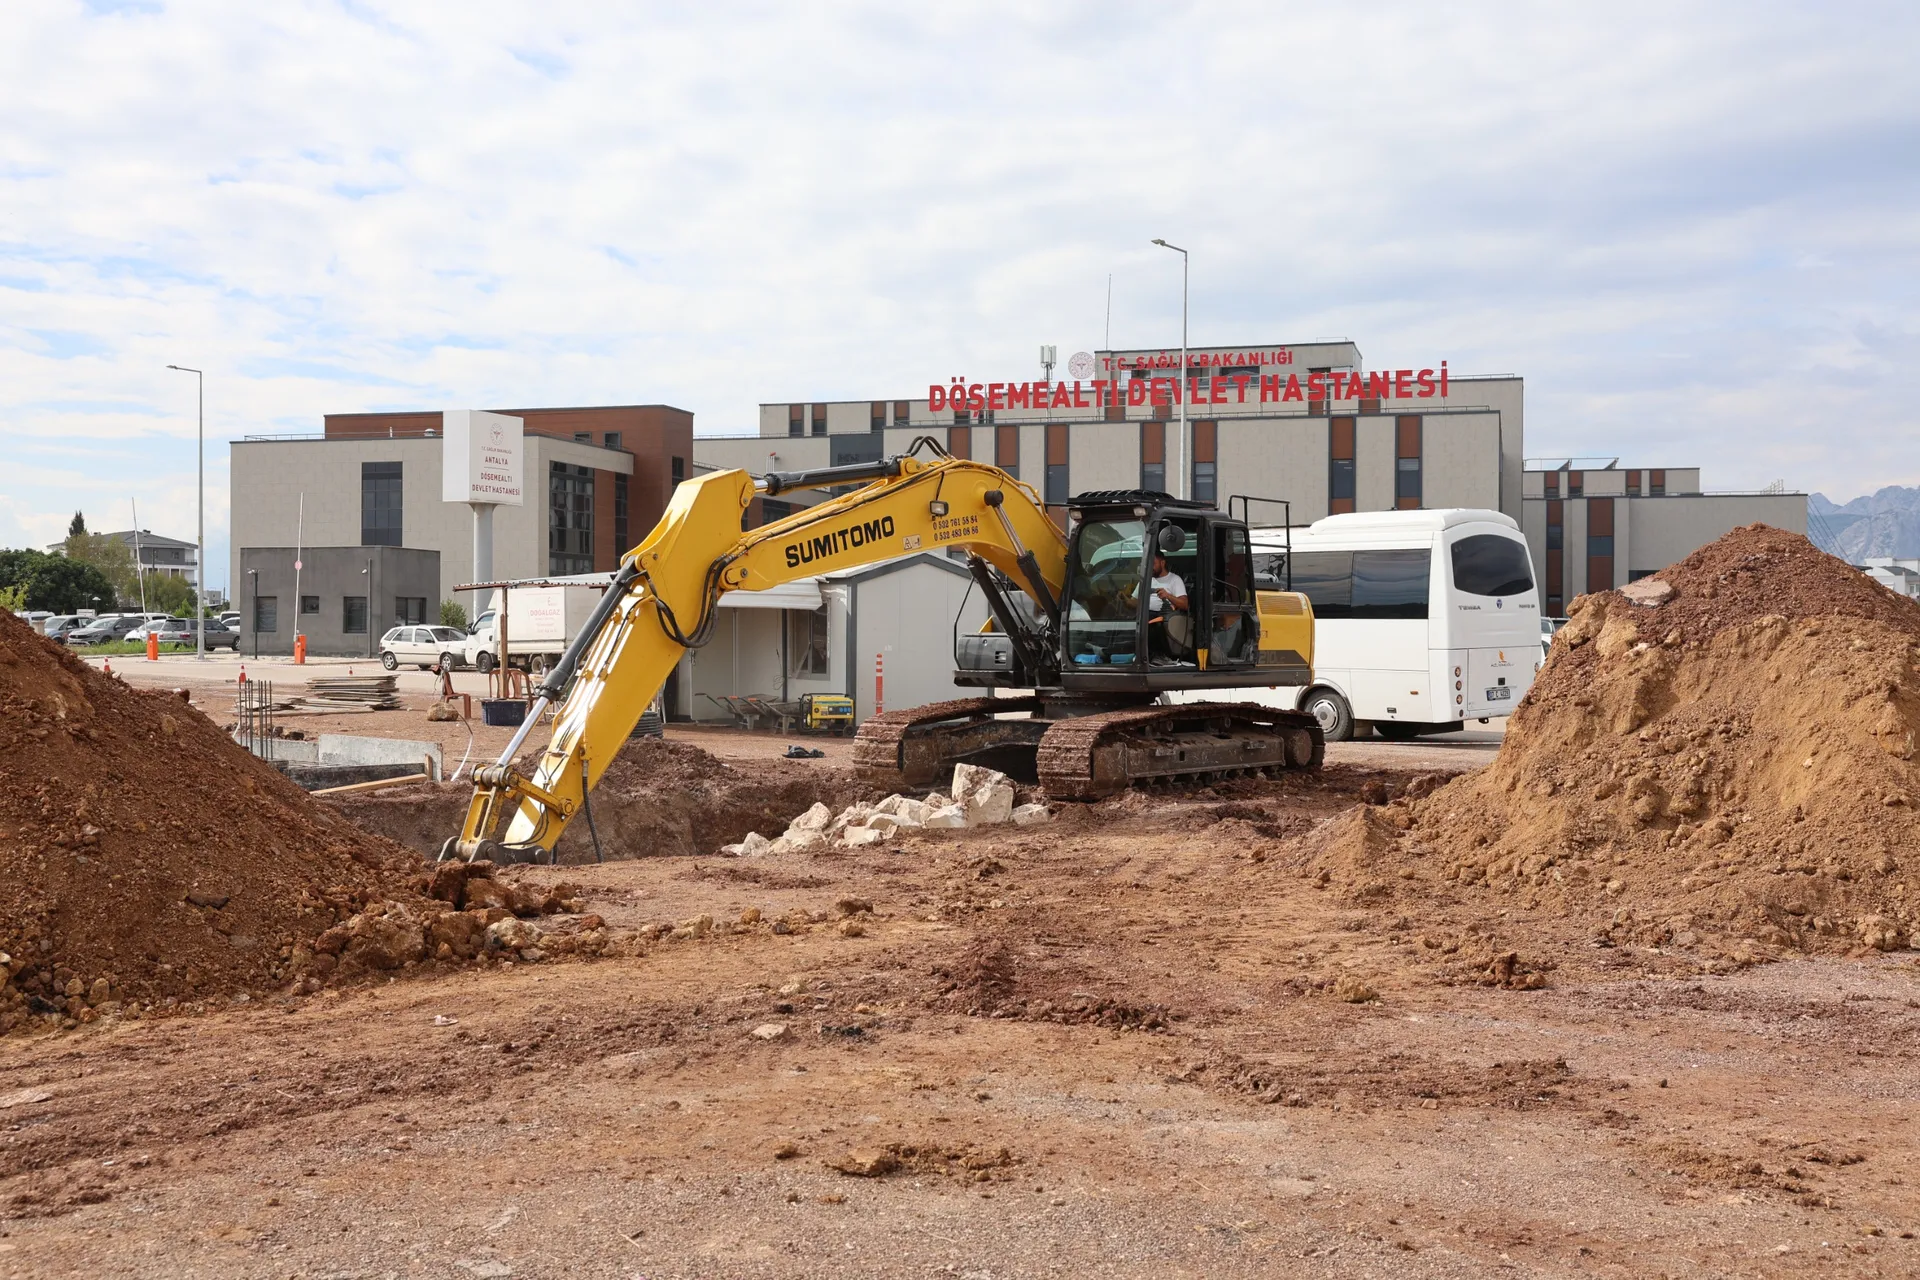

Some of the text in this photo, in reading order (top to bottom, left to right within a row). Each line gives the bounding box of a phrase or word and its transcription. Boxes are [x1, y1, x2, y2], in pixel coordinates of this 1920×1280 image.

[1102, 357, 1132, 372] T.C.
[1199, 347, 1293, 368] BAKANLIĞI
[928, 376, 1119, 418] DÖŞEMEALTI
[1259, 360, 1448, 403] HASTANESİ
[484, 456, 509, 465] ANTALYA
[480, 472, 513, 482] DÖŞEMEALTI
[472, 484, 521, 496] DEVLET HASTANESİ
[932, 521, 938, 531] 0
[938, 520, 949, 530] 532
[950, 518, 961, 527] 761
[785, 515, 895, 568] SUMITOMO
[933, 532, 939, 542] 0
[939, 530, 951, 541] 532
